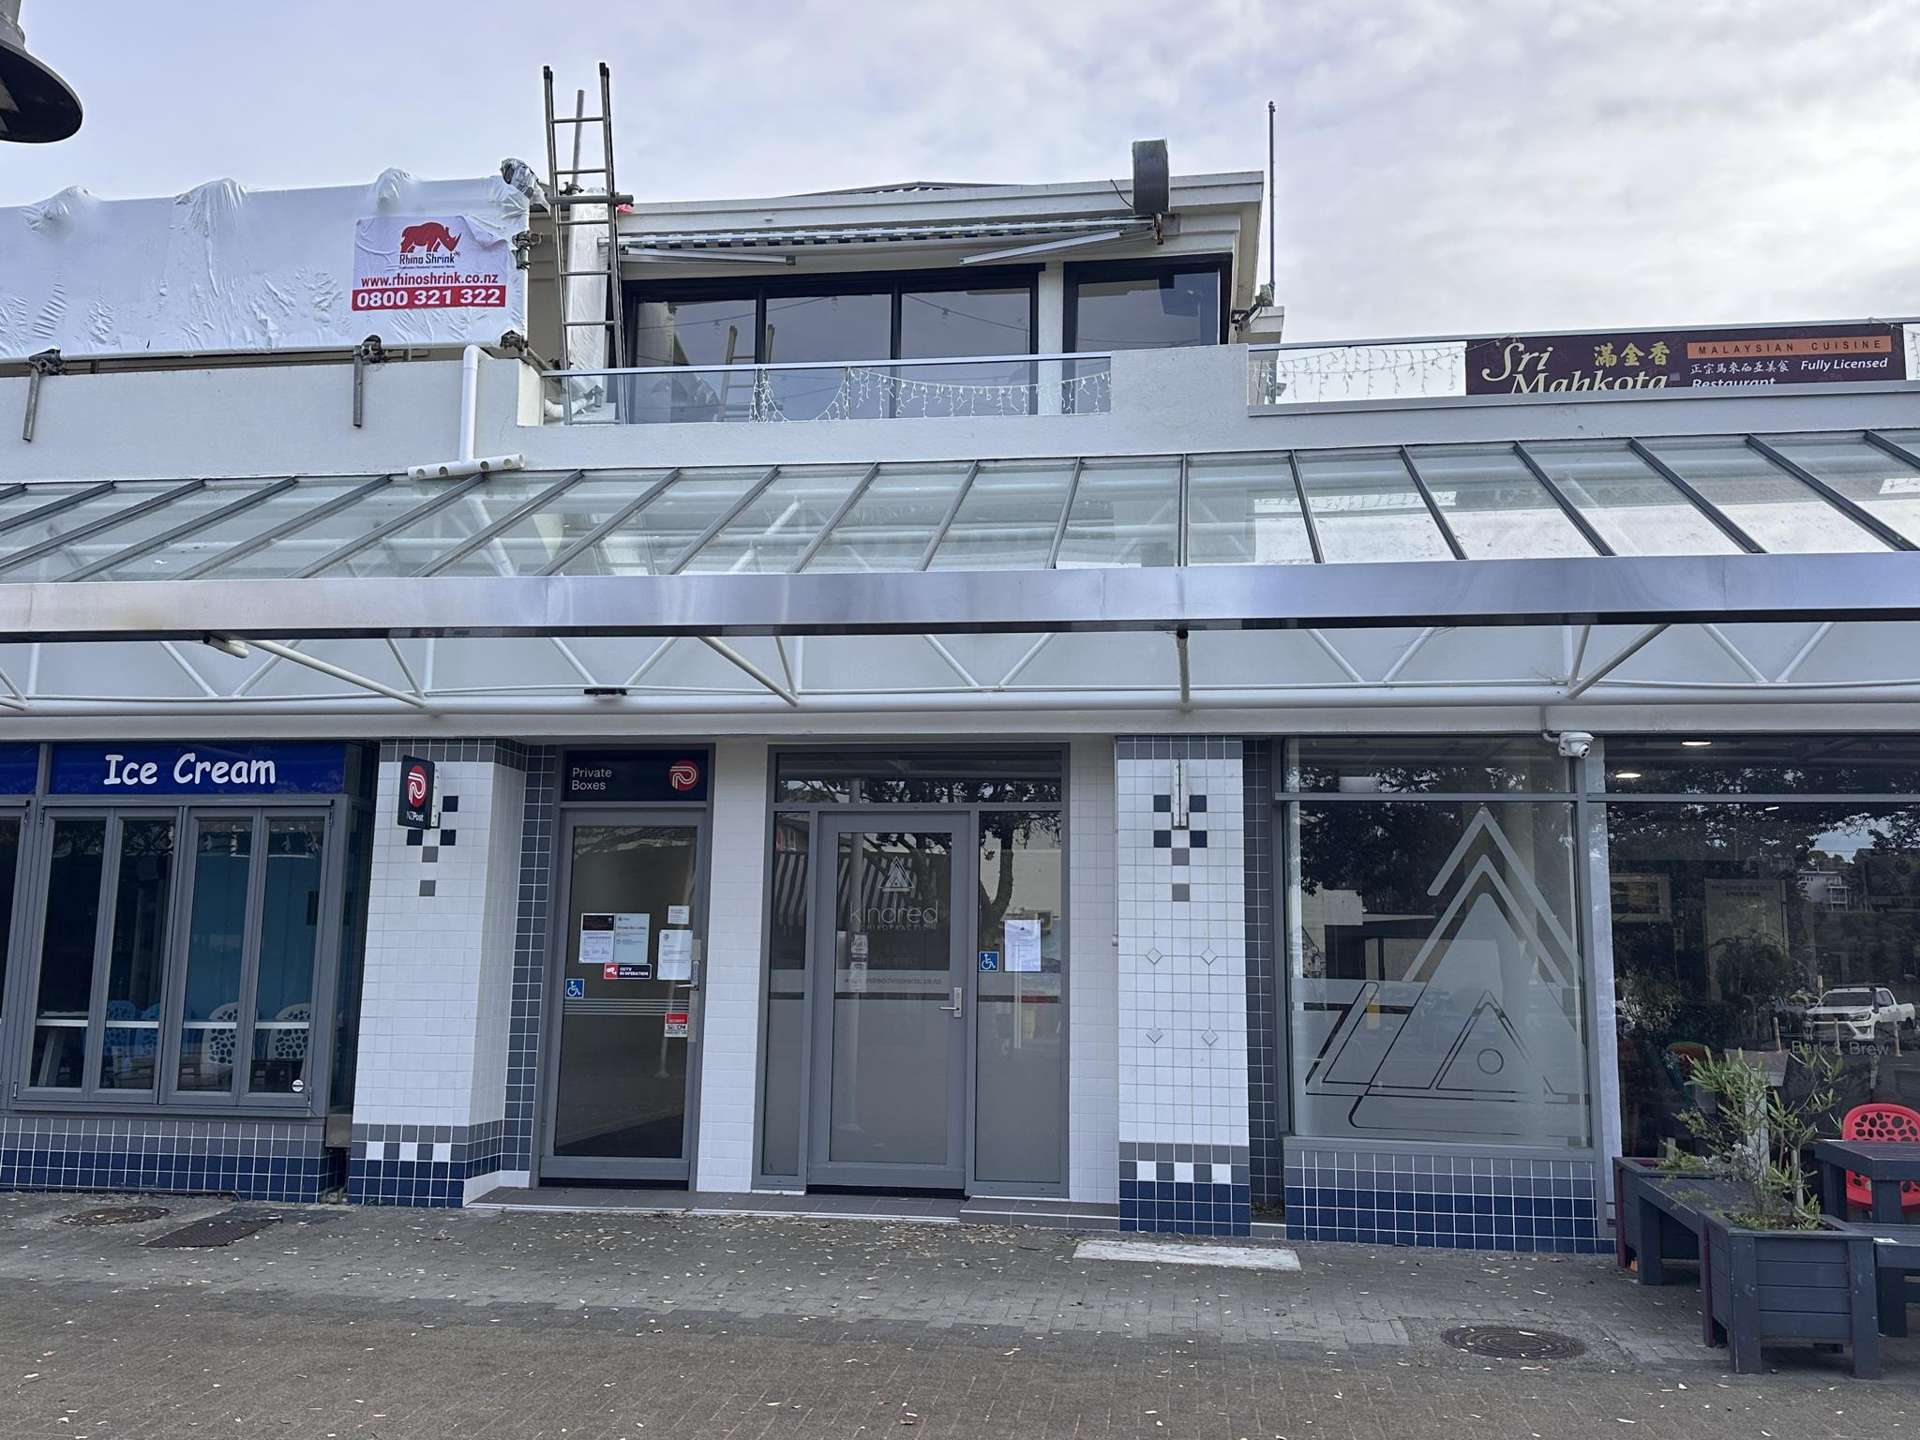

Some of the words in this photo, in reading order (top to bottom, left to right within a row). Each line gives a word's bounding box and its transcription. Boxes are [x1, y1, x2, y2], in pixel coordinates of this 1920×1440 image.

[400, 254, 424, 265] Rhino
[426, 253, 455, 264] Shrink
[361, 271, 498, 287] www.rhinoshrink.co.nz
[356, 290, 409, 307] 0800
[414, 289, 452, 305] 321
[460, 288, 501, 304] 322
[1699, 343, 1794, 355] MALAYSIAN
[1811, 340, 1881, 351] CUISINE
[1481, 342, 1554, 382] Sri
[1801, 359, 1830, 372] Fully
[1834, 357, 1888, 370] Licensed
[1511, 369, 1668, 394] Mahkota
[104, 754, 157, 785] Ice
[173, 752, 276, 785] Cream
[572, 767, 613, 778] Private
[571, 780, 606, 791] Boxes
[1849, 1041, 1889, 1055] Brew
